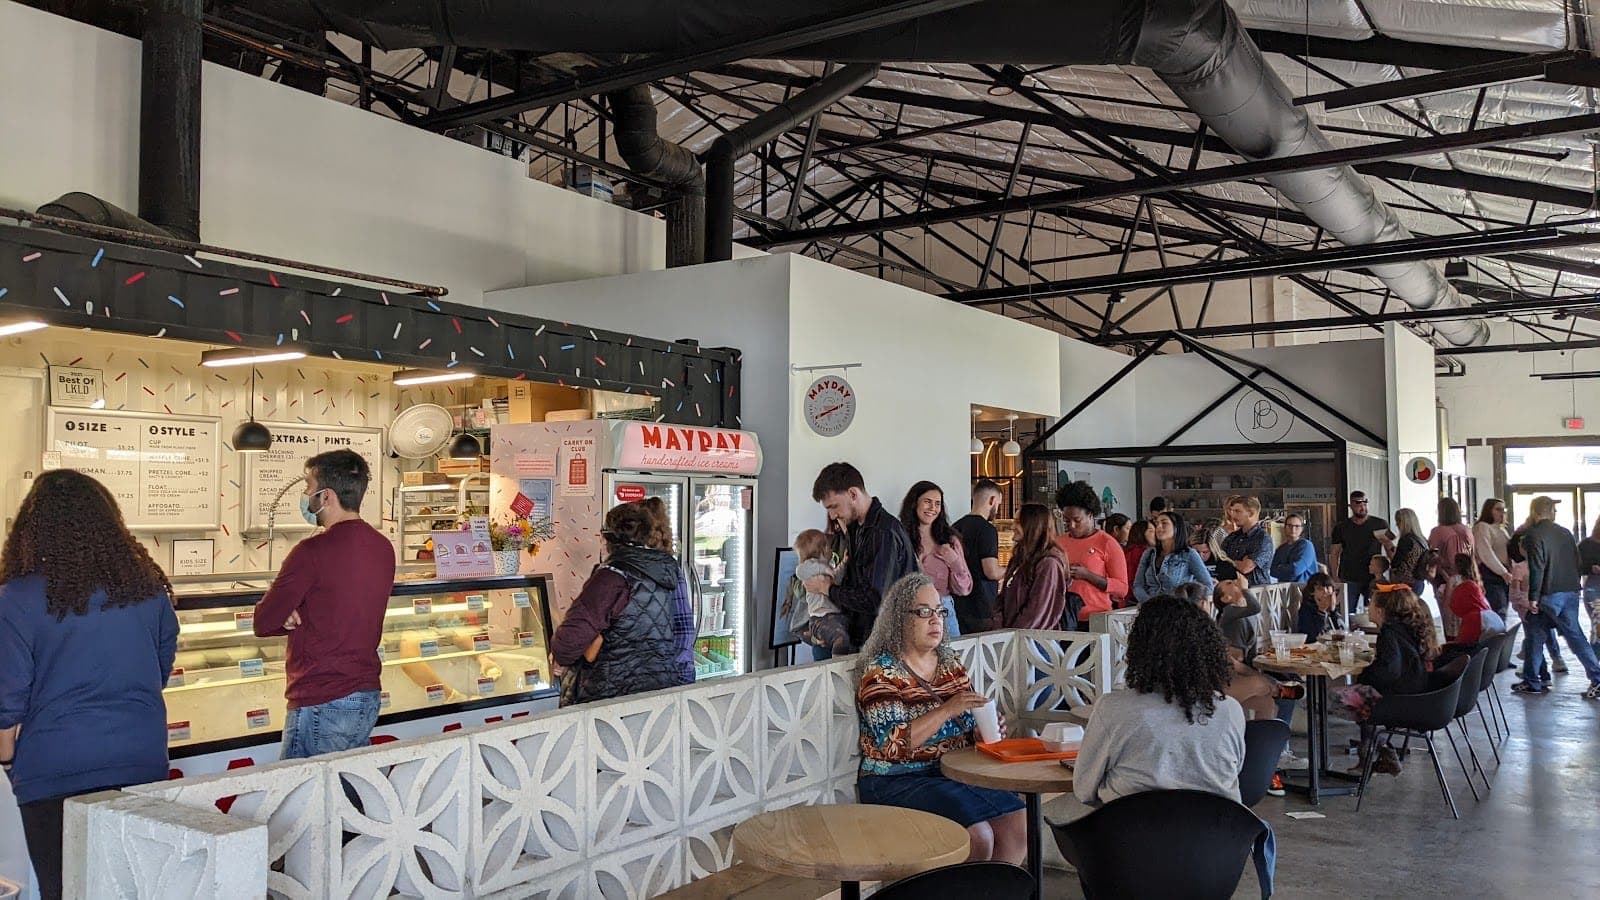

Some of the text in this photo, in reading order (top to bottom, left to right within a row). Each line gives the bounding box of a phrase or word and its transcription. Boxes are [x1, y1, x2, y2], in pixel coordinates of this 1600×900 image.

[59, 376, 80, 384] Best
[66, 384, 88, 394] LKLD
[808, 380, 850, 400] MAYDAY
[78, 422, 107, 432] SIZE
[160, 426, 196, 436] STYLE
[272, 434, 308, 443] EXTRAS
[325, 437, 351, 445] PINTS
[641, 425, 742, 454] MAYDAY
[641, 454, 740, 470] handcrafted ice creams
